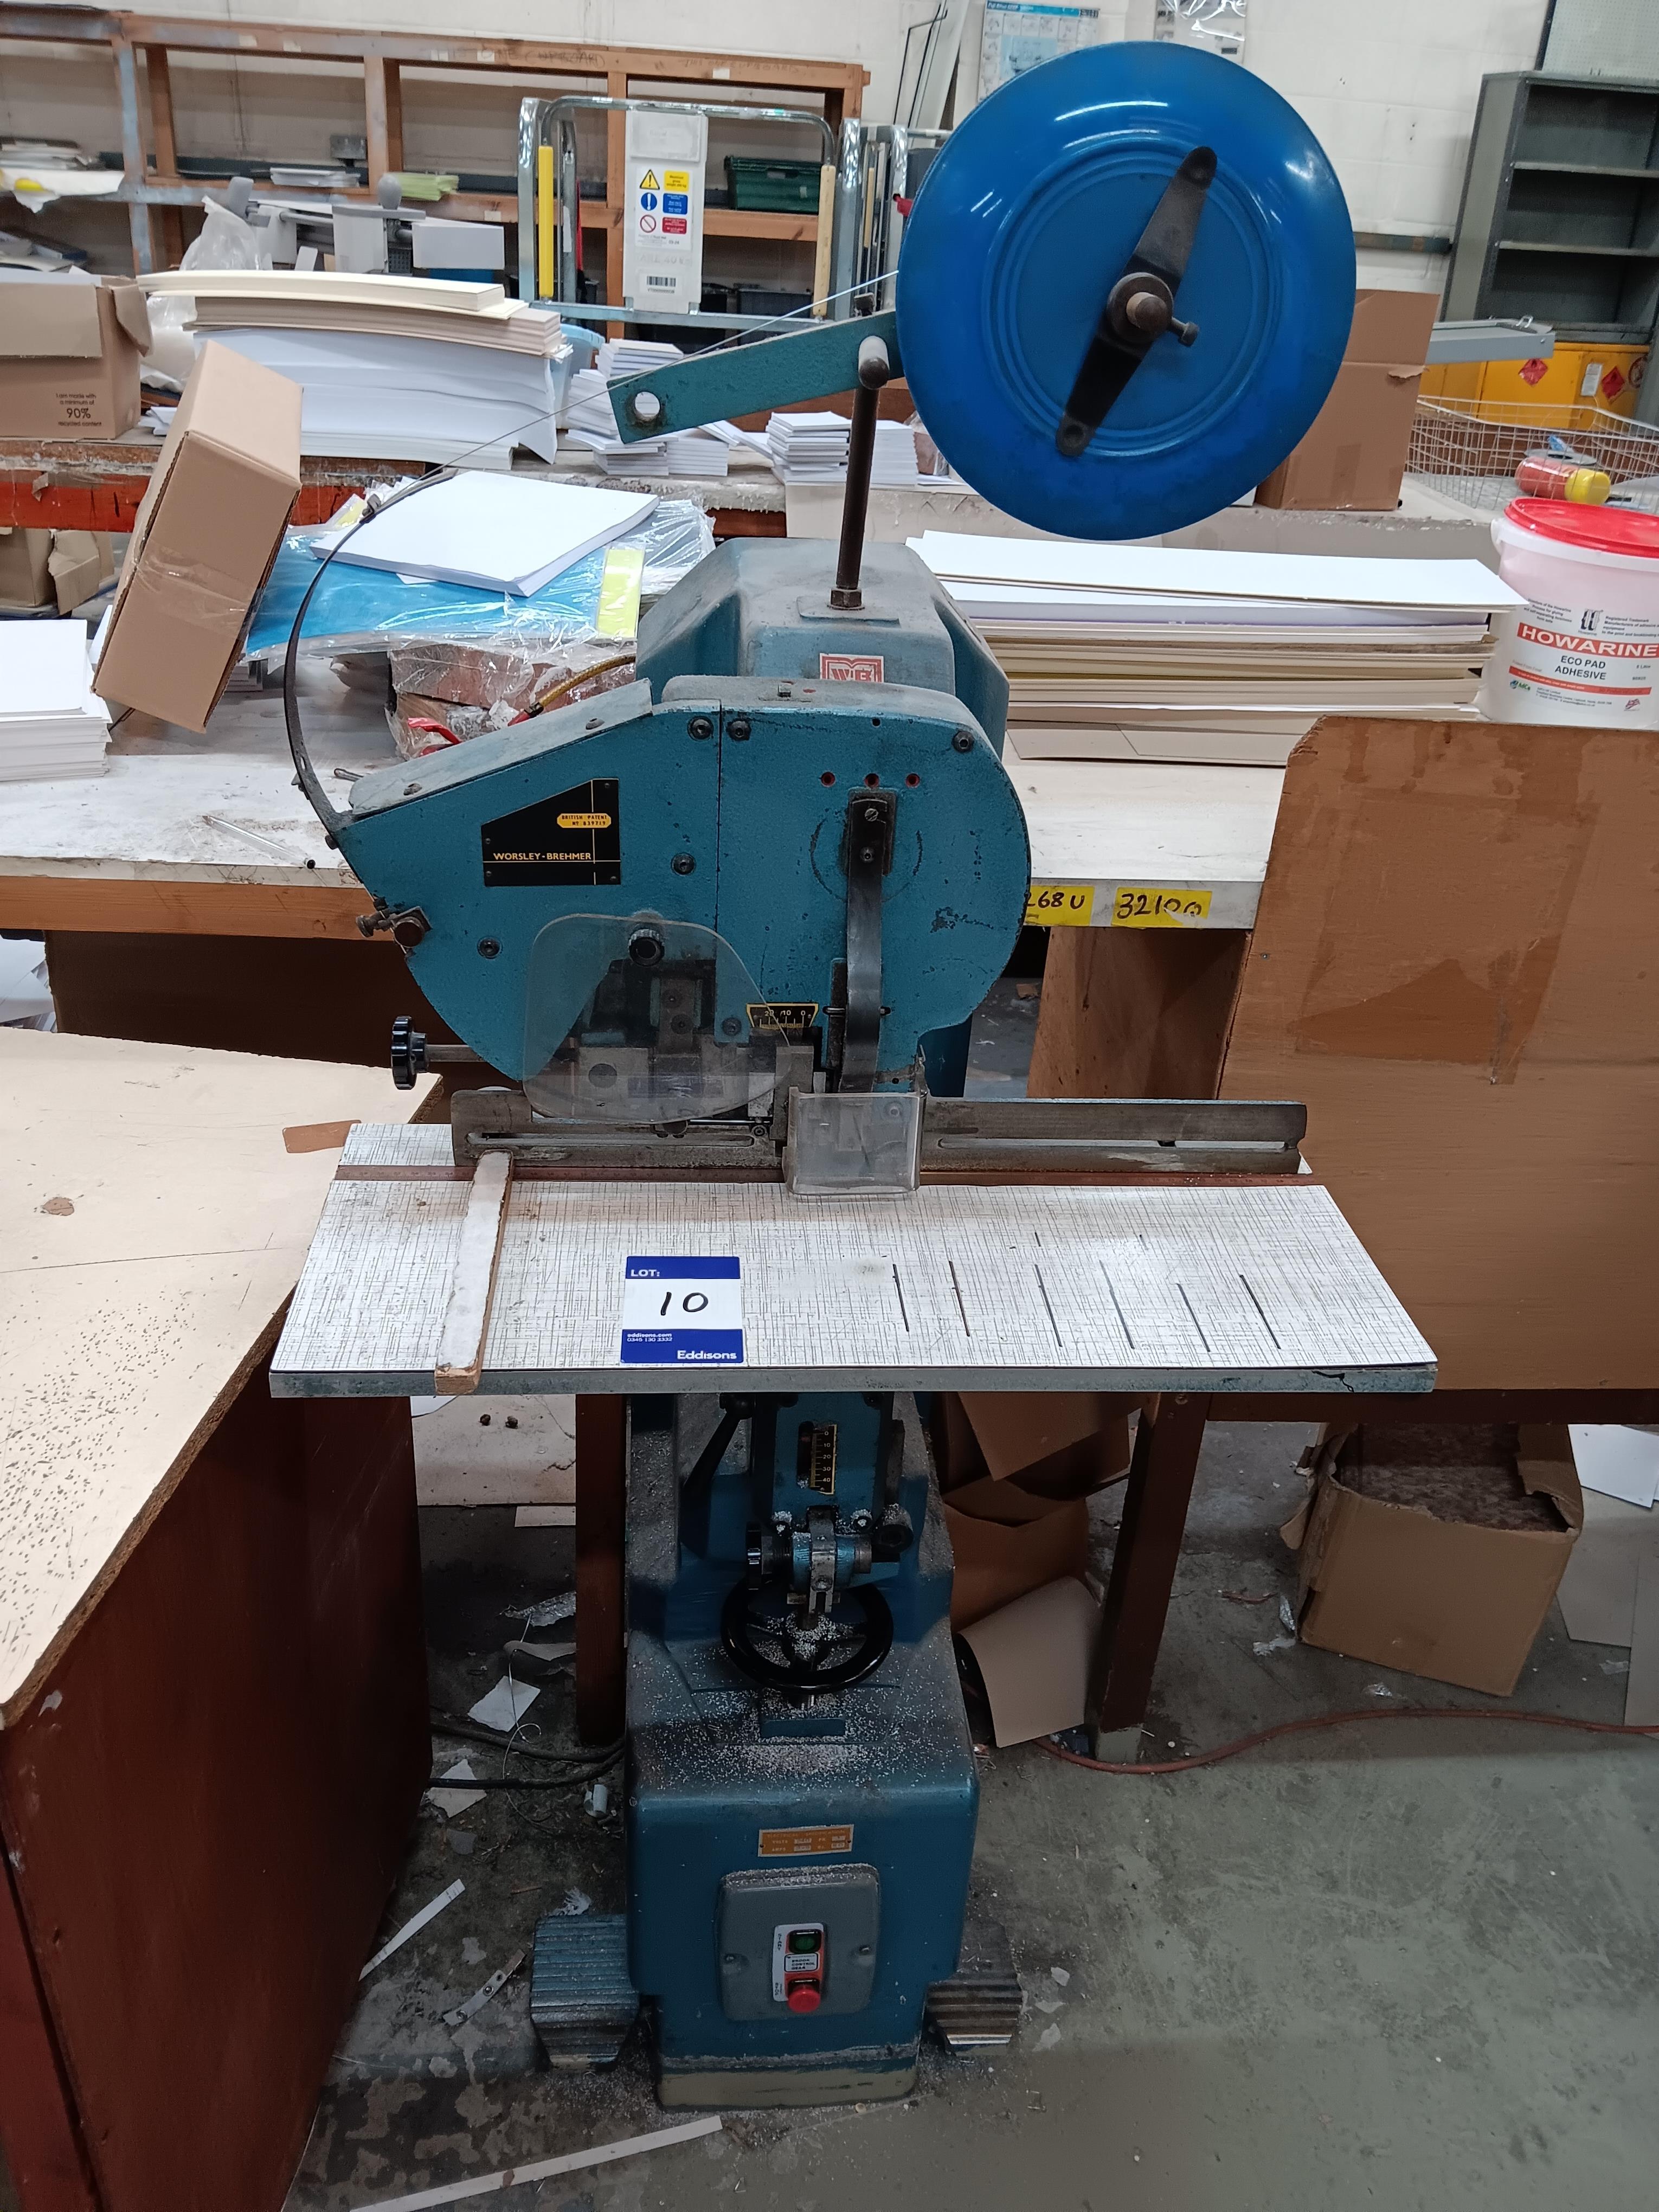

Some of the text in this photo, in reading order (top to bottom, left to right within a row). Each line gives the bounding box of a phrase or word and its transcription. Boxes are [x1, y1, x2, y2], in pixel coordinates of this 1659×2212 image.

[67, 408, 91, 419] 90%
[1522, 626, 1658, 657] HOWARINE
[1561, 655, 1606, 669] ECO PAD
[1555, 666, 1606, 680] ADHESIVE
[660, 1291, 709, 1316] 10
[677, 1350, 737, 1360] Eddisons
